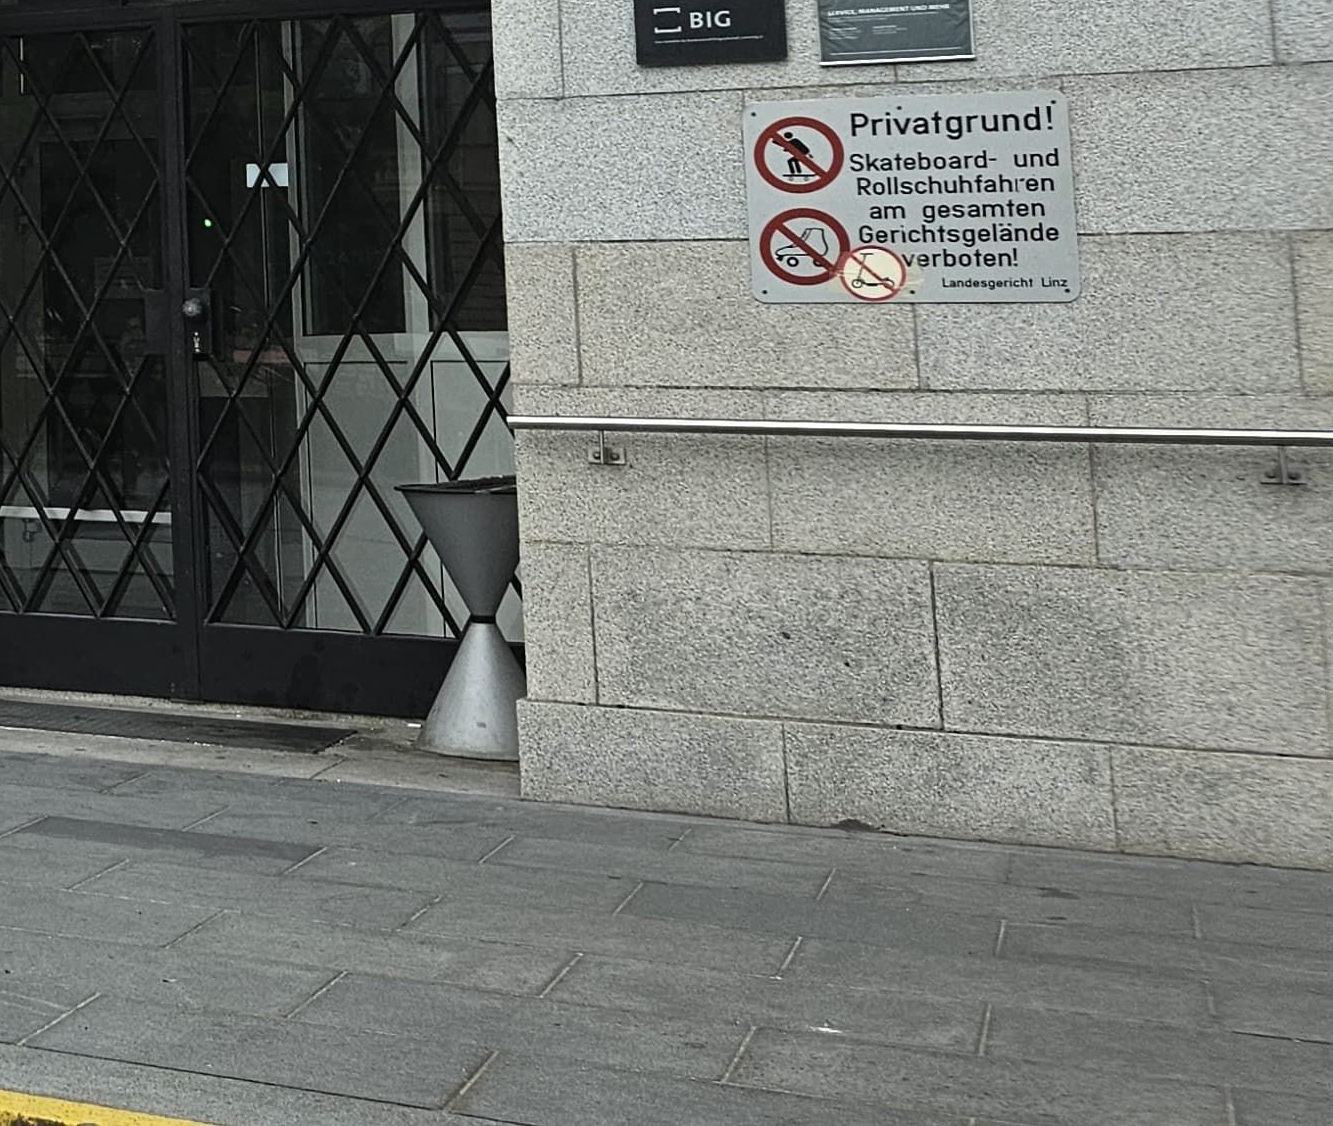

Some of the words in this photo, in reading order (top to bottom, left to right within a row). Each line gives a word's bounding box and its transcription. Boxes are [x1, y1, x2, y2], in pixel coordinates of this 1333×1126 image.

[689, 10, 731, 29] BIG
[850, 105, 1054, 140] Privatgrund!
[849, 150, 997, 173] Skateboard-
[1013, 148, 1060, 168] und
[856, 173, 1056, 196] Rollschuhfahren
[869, 204, 906, 220] am
[922, 198, 1046, 224] gesamten
[858, 222, 1060, 248] Gerichtsgelände
[901, 248, 1019, 268] verboten!
[941, 277, 1033, 290] Landesgericht
[1040, 276, 1069, 288] Linz
